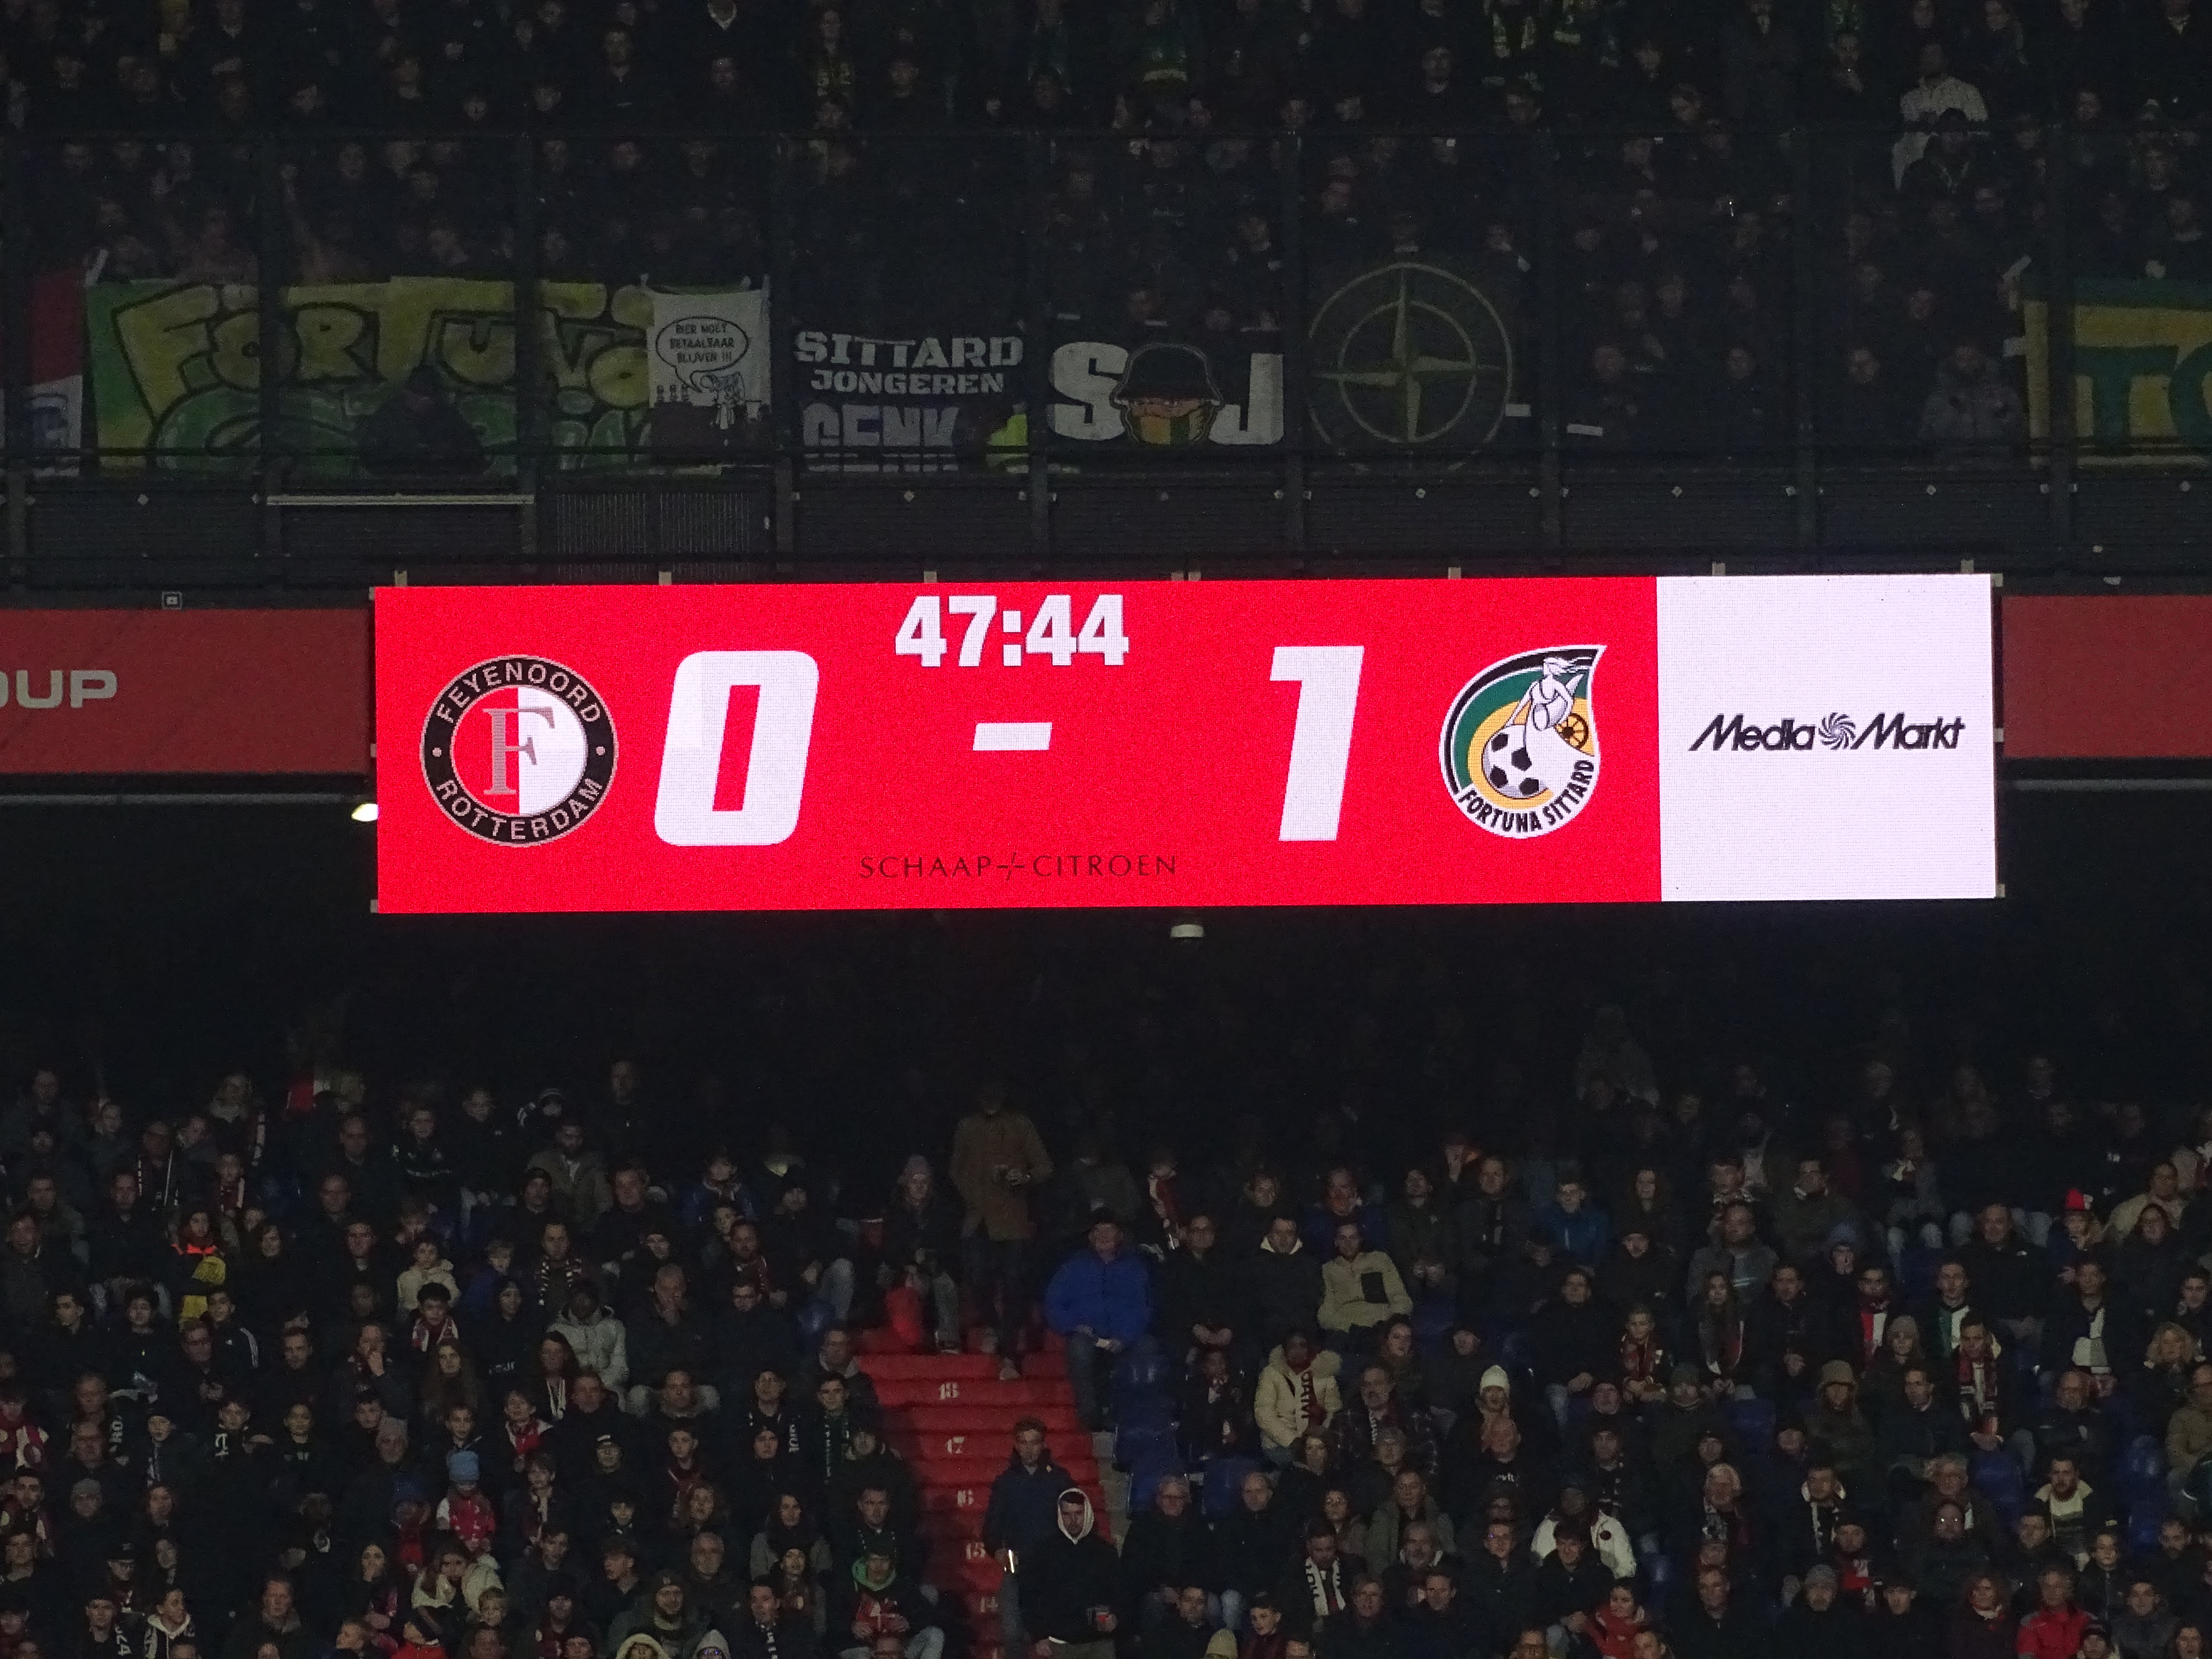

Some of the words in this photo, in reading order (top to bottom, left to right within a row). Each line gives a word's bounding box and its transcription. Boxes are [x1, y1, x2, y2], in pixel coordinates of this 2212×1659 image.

[676, 324, 697, 334] BIER
[701, 323, 728, 334] MOET
[794, 331, 1024, 368] SITTARD
[810, 369, 1004, 395] JONGEREN
[895, 594, 1129, 667] 47:44
[0, 670, 117, 709] UP
[435, 662, 601, 723] FEYENOORD
[653, 650, 820, 847] 0
[1269, 646, 1365, 842] 1
[1688, 713, 1816, 751] Media
[1850, 712, 1966, 750] Markt
[437, 778, 603, 840] ROTTERDAM
[1458, 790, 1542, 832] FORTUNA
[1542, 760, 1595, 825] SITTARD
